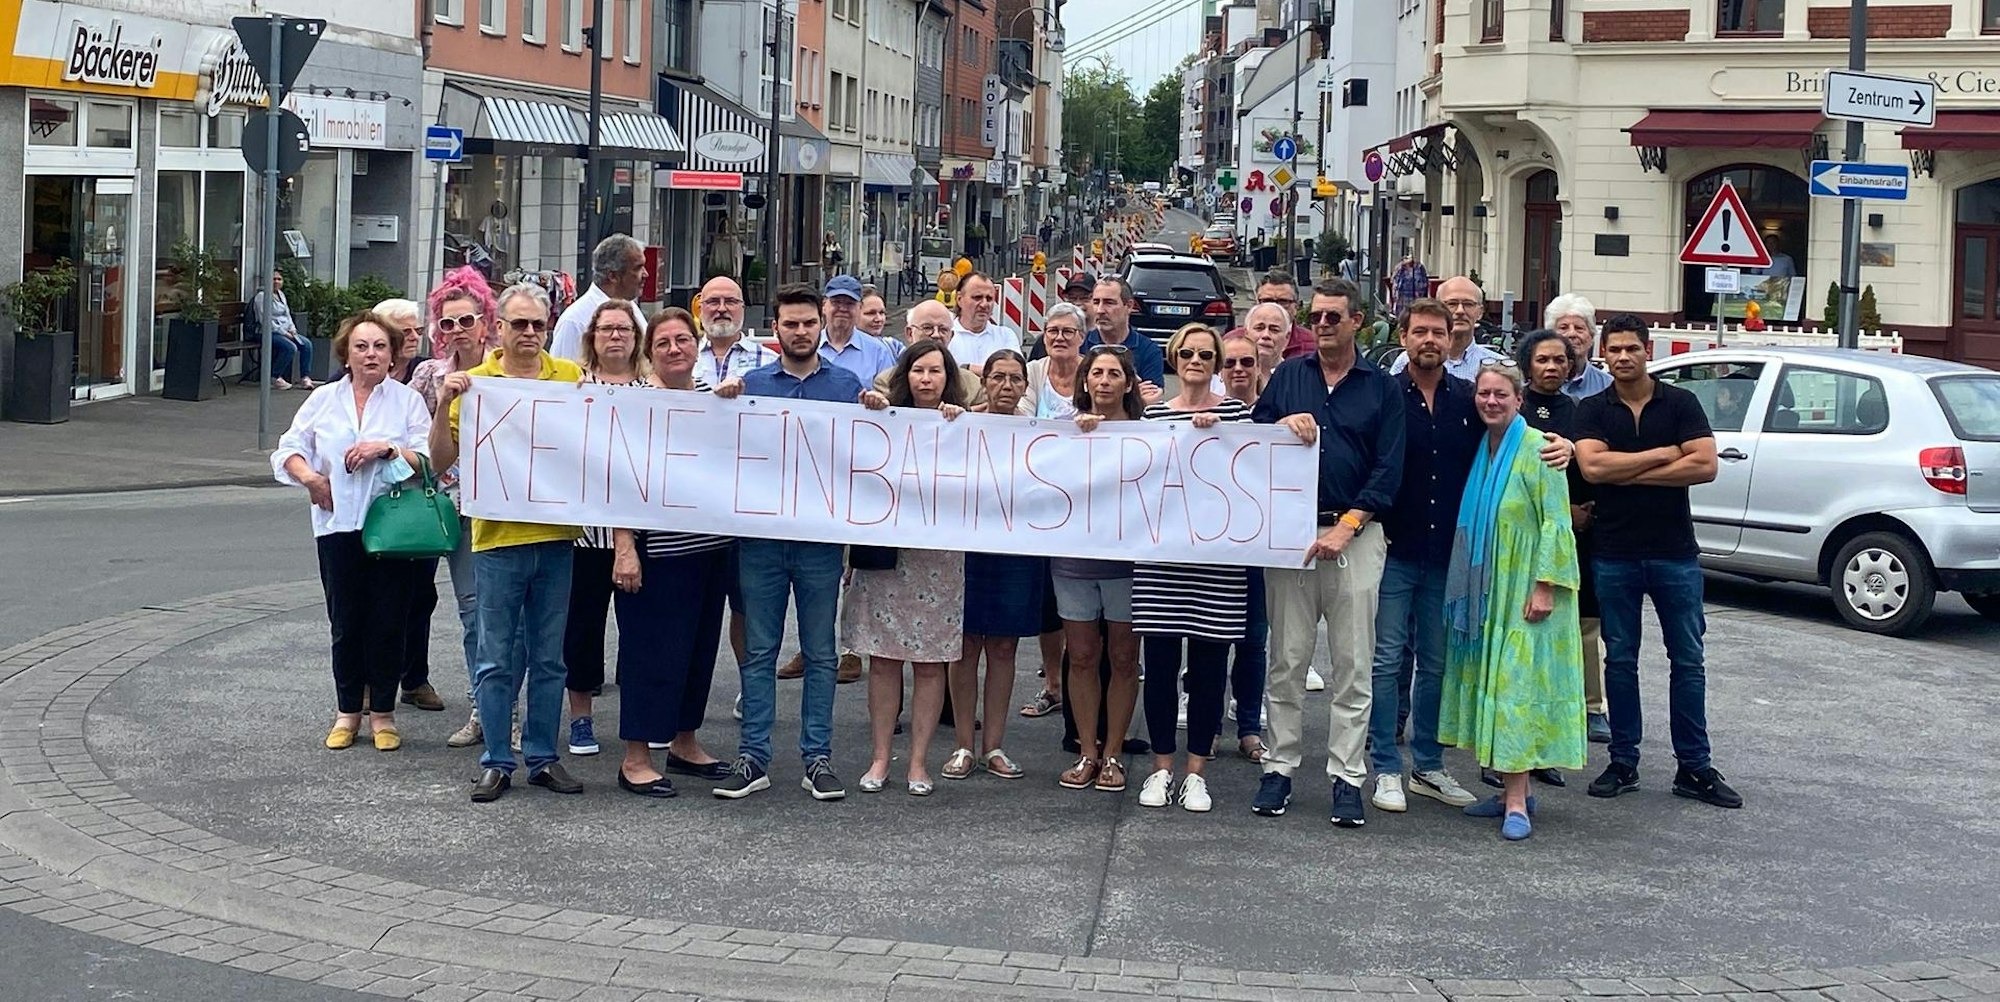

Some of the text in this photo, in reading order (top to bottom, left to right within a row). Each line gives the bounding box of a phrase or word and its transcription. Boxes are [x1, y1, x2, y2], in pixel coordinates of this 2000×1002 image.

[69, 25, 162, 82] Bäckerei
[986, 79, 995, 142] HOTEL
[1848, 87, 1904, 109] Zentrum
[323, 108, 382, 141] Immobilien
[1839, 174, 1903, 187] Einbahnstraße
